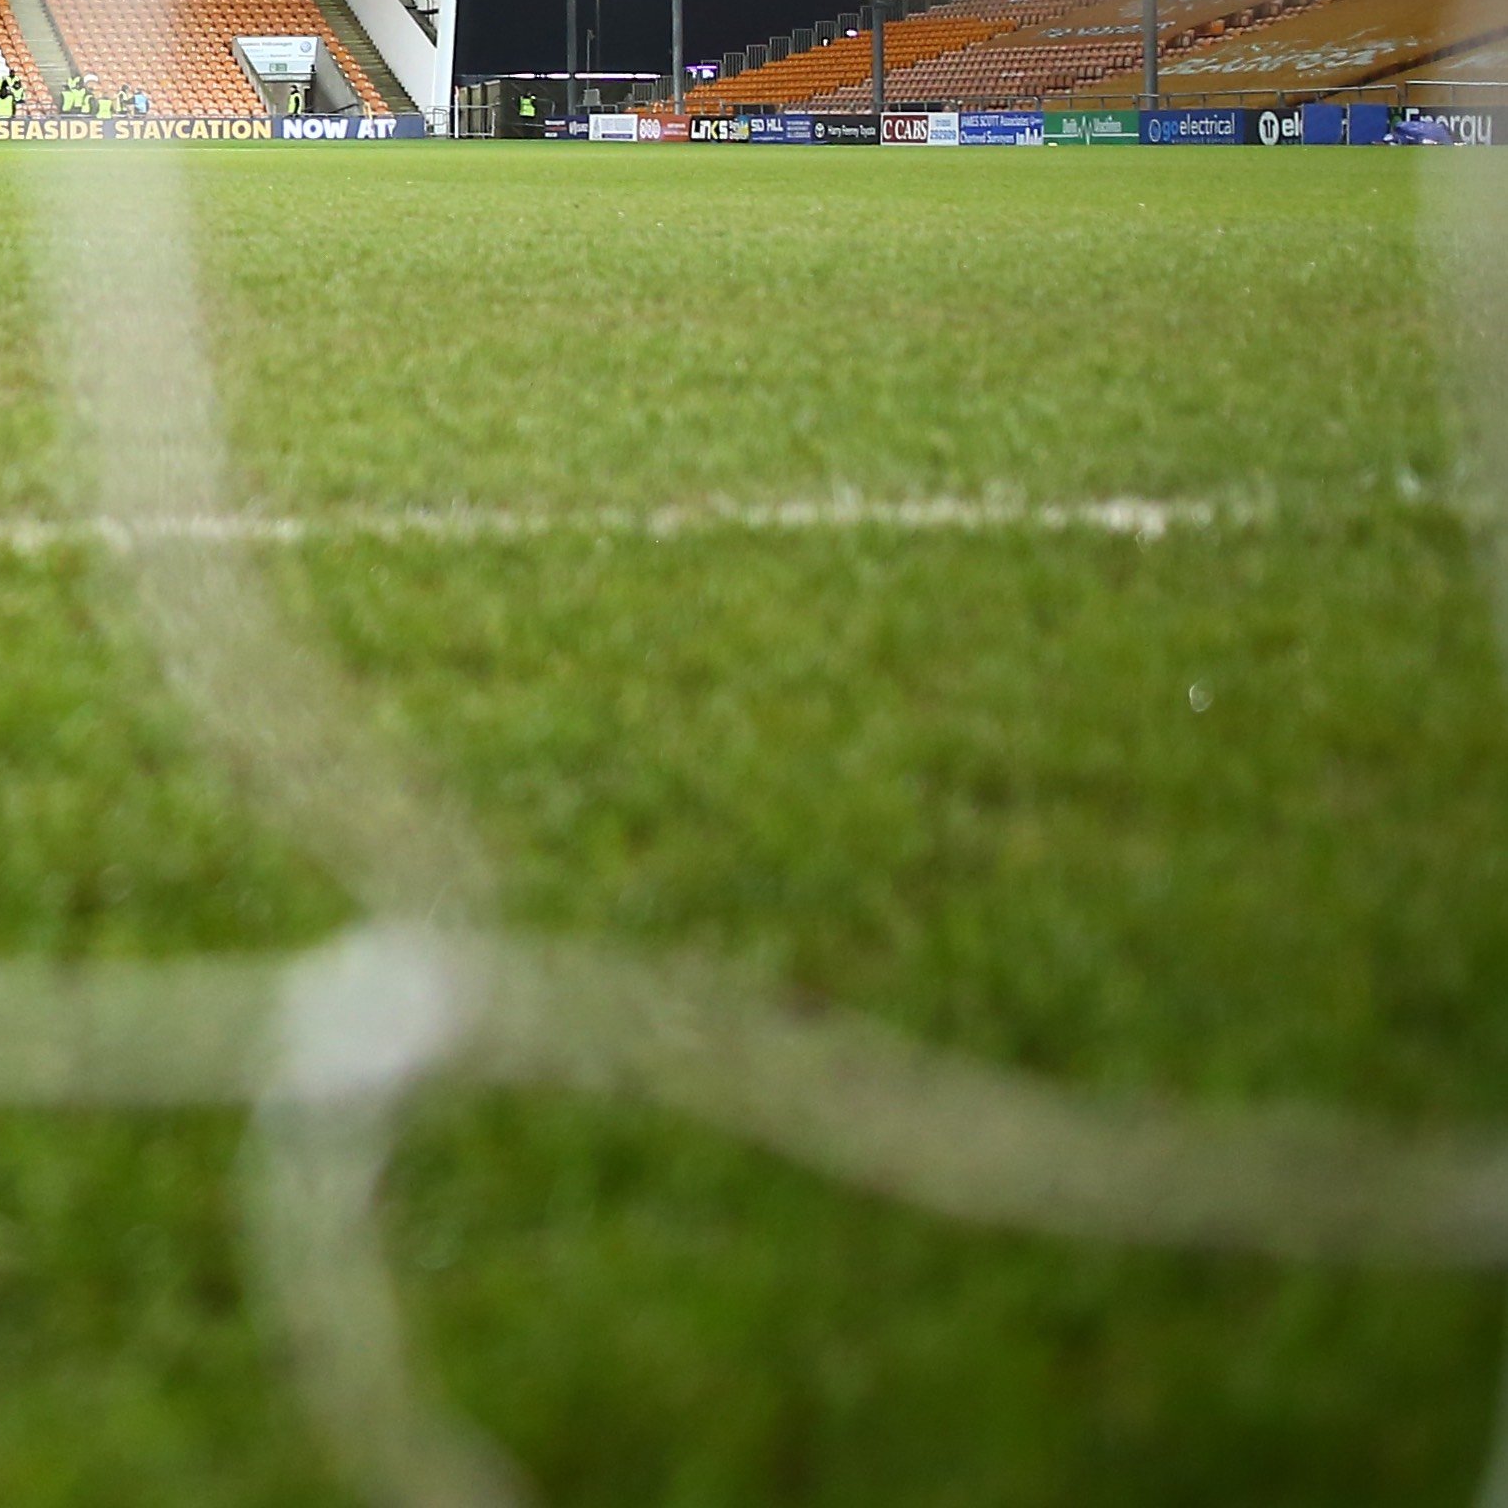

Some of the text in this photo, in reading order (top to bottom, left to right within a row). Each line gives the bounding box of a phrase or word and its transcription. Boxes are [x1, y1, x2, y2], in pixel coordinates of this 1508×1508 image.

[114, 119, 272, 139] STAYCATION
[283, 119, 349, 139] NOW
[357, 119, 393, 139] AT
[883, 118, 928, 141] C CABS
